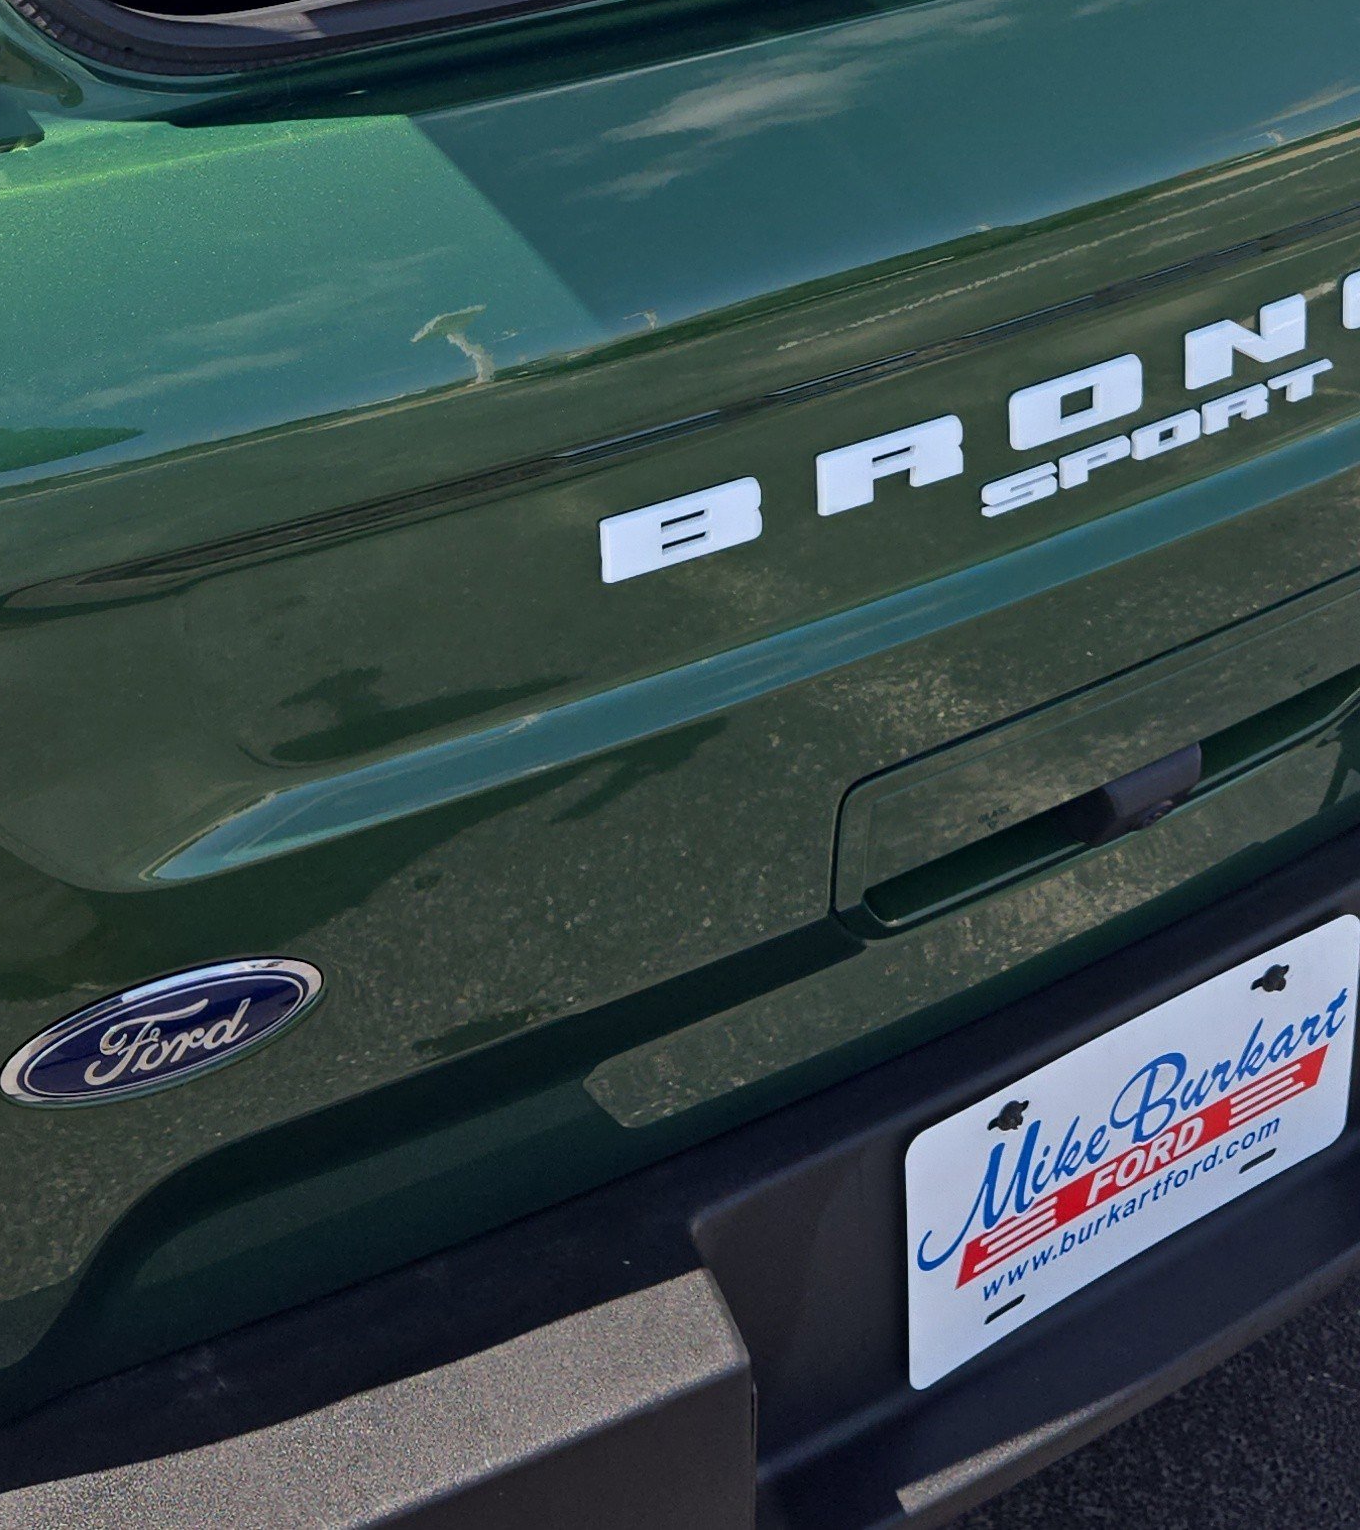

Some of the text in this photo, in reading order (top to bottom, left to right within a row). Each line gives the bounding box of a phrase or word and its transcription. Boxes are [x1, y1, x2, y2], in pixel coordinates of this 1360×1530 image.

[981, 358, 1332, 518] SPORT
[84, 997, 251, 1086] Ford
[916, 987, 1349, 1272] Mike Burkart
[981, 1116, 1282, 1302] www.burkartford.com
[1085, 1116, 1205, 1208] FORD
